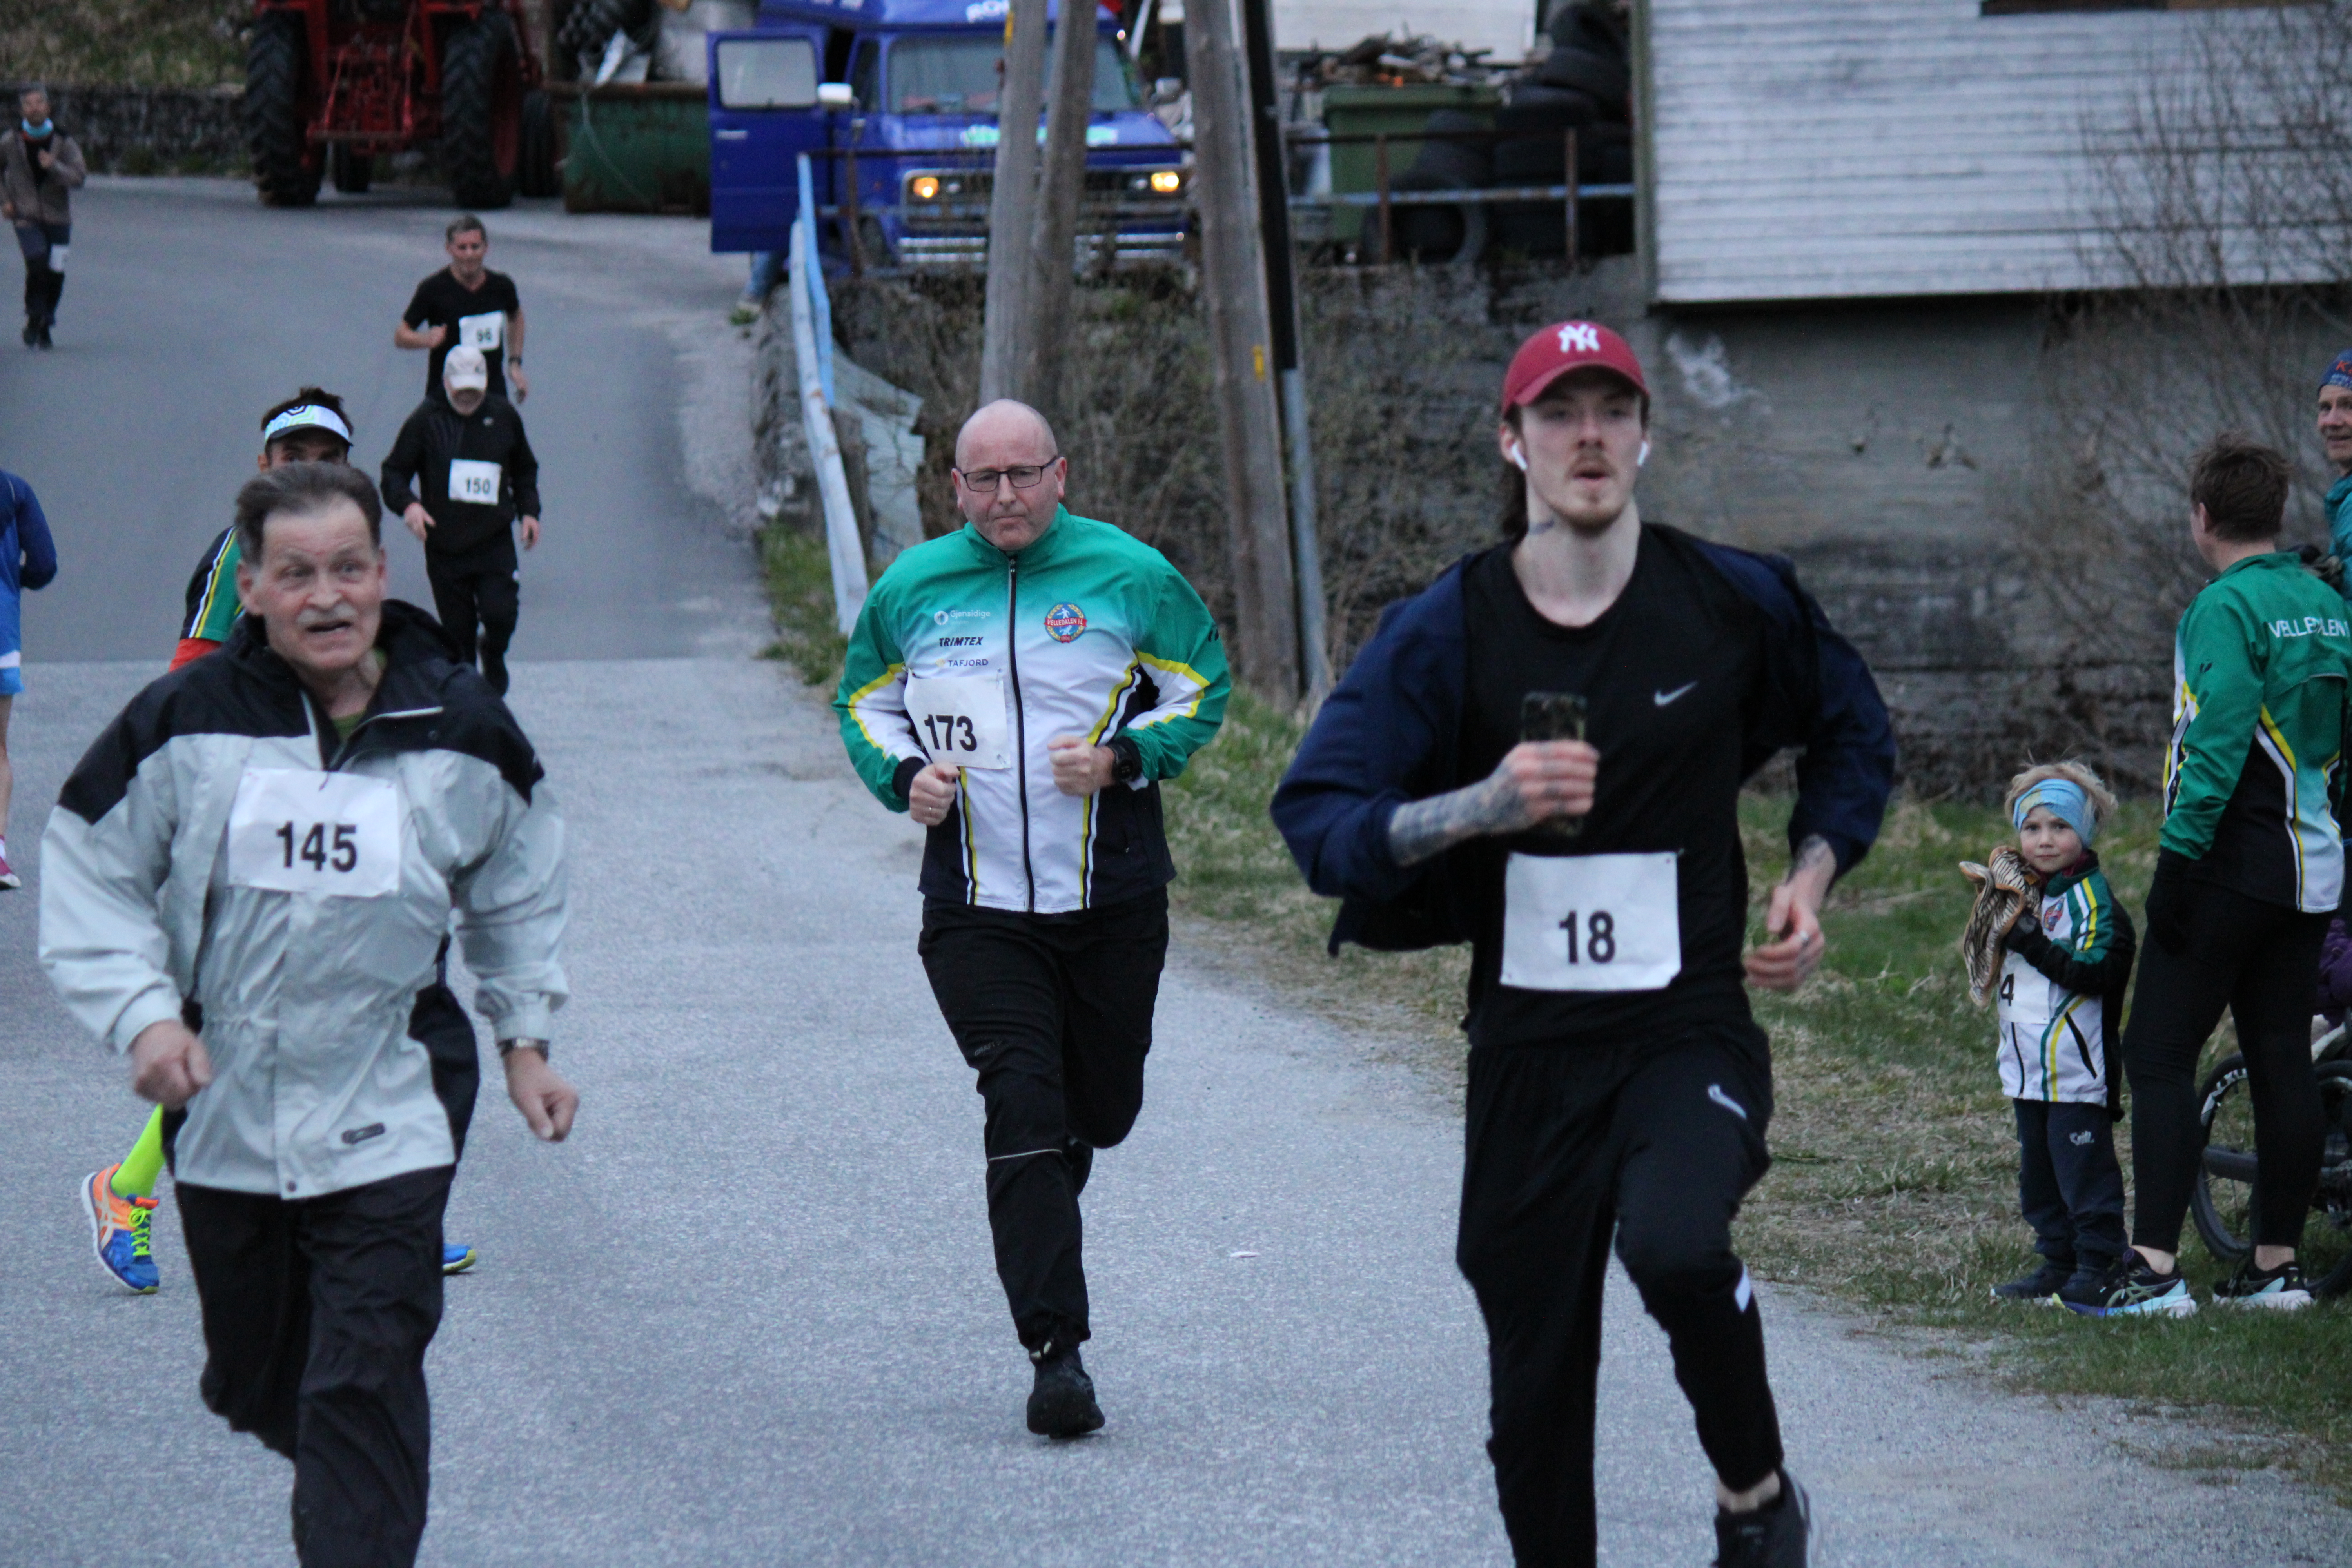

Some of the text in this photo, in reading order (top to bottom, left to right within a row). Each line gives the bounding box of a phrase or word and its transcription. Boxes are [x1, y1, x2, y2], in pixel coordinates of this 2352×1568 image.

[465, 477, 490, 494] 150
[950, 610, 990, 619] Gjensidige
[939, 637, 984, 647] TRIMTEX
[924, 714, 977, 751] 173
[276, 820, 358, 873] 145
[1559, 910, 1615, 964] 18
[1998, 973, 2014, 1007] 4
